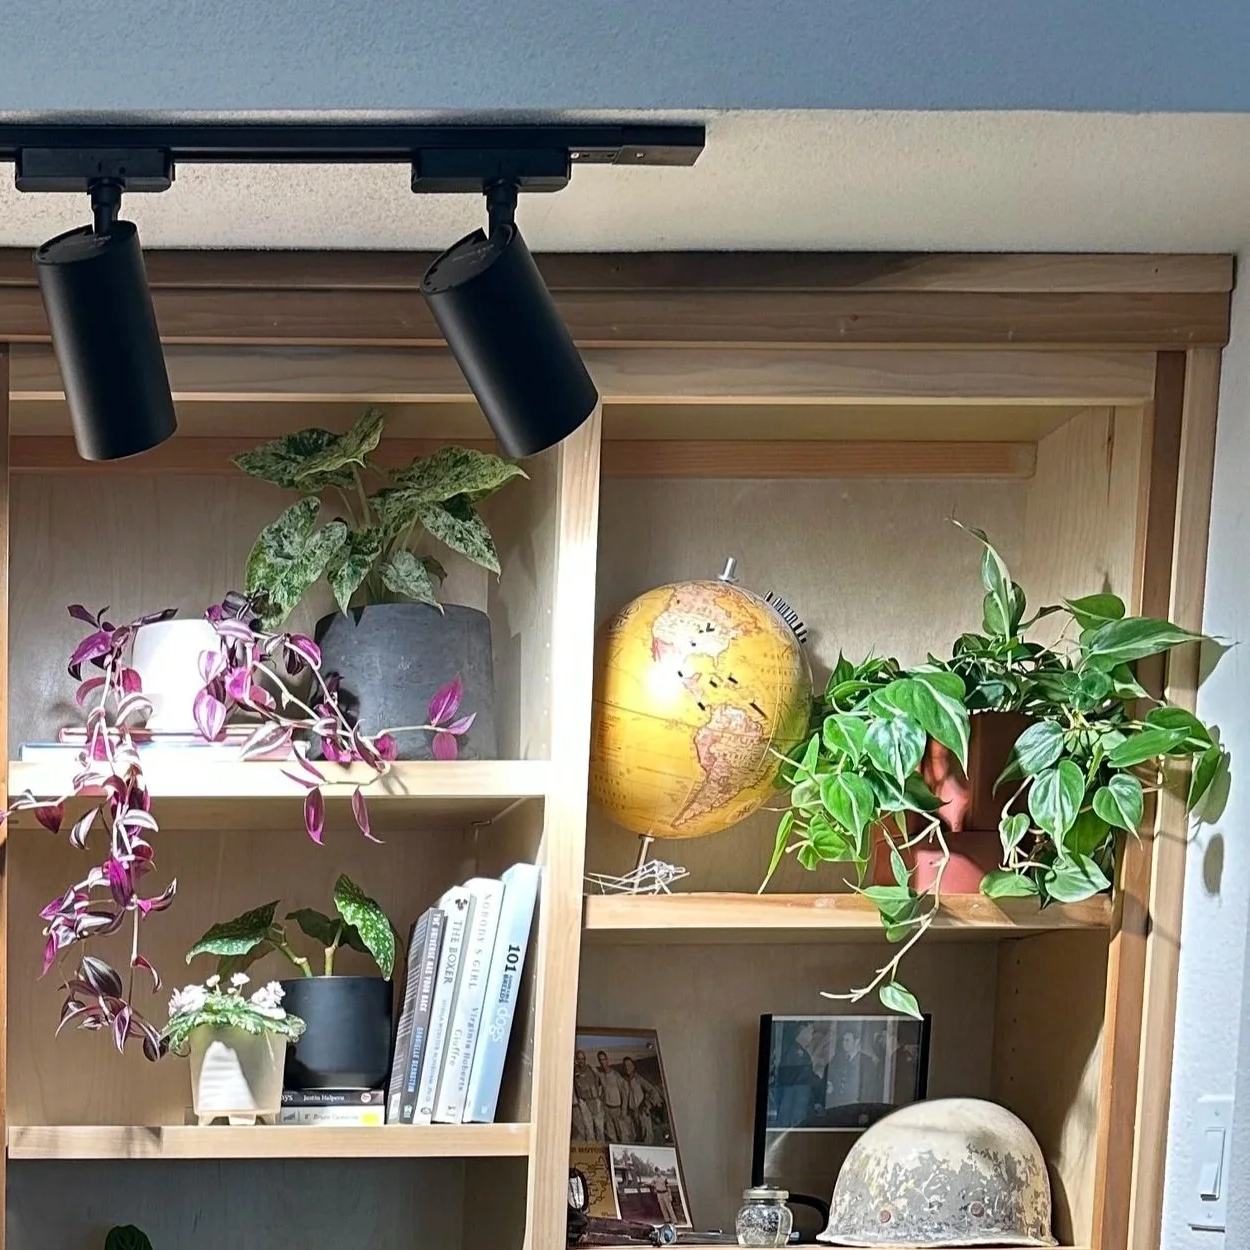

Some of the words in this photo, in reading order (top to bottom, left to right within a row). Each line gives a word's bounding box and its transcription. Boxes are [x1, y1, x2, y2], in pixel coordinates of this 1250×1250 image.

[433, 913, 441, 927] THE
[450, 921, 462, 943] THE
[444, 947, 458, 985] BOXER
[469, 959, 481, 989] GIRL
[504, 944, 520, 972] 101
[420, 994, 430, 1012] BACK
[465, 1007, 479, 1050] Virginia
[490, 1007, 510, 1042] dogs
[449, 1029, 462, 1066] Giuffre
[457, 1052, 471, 1091] Roberts
